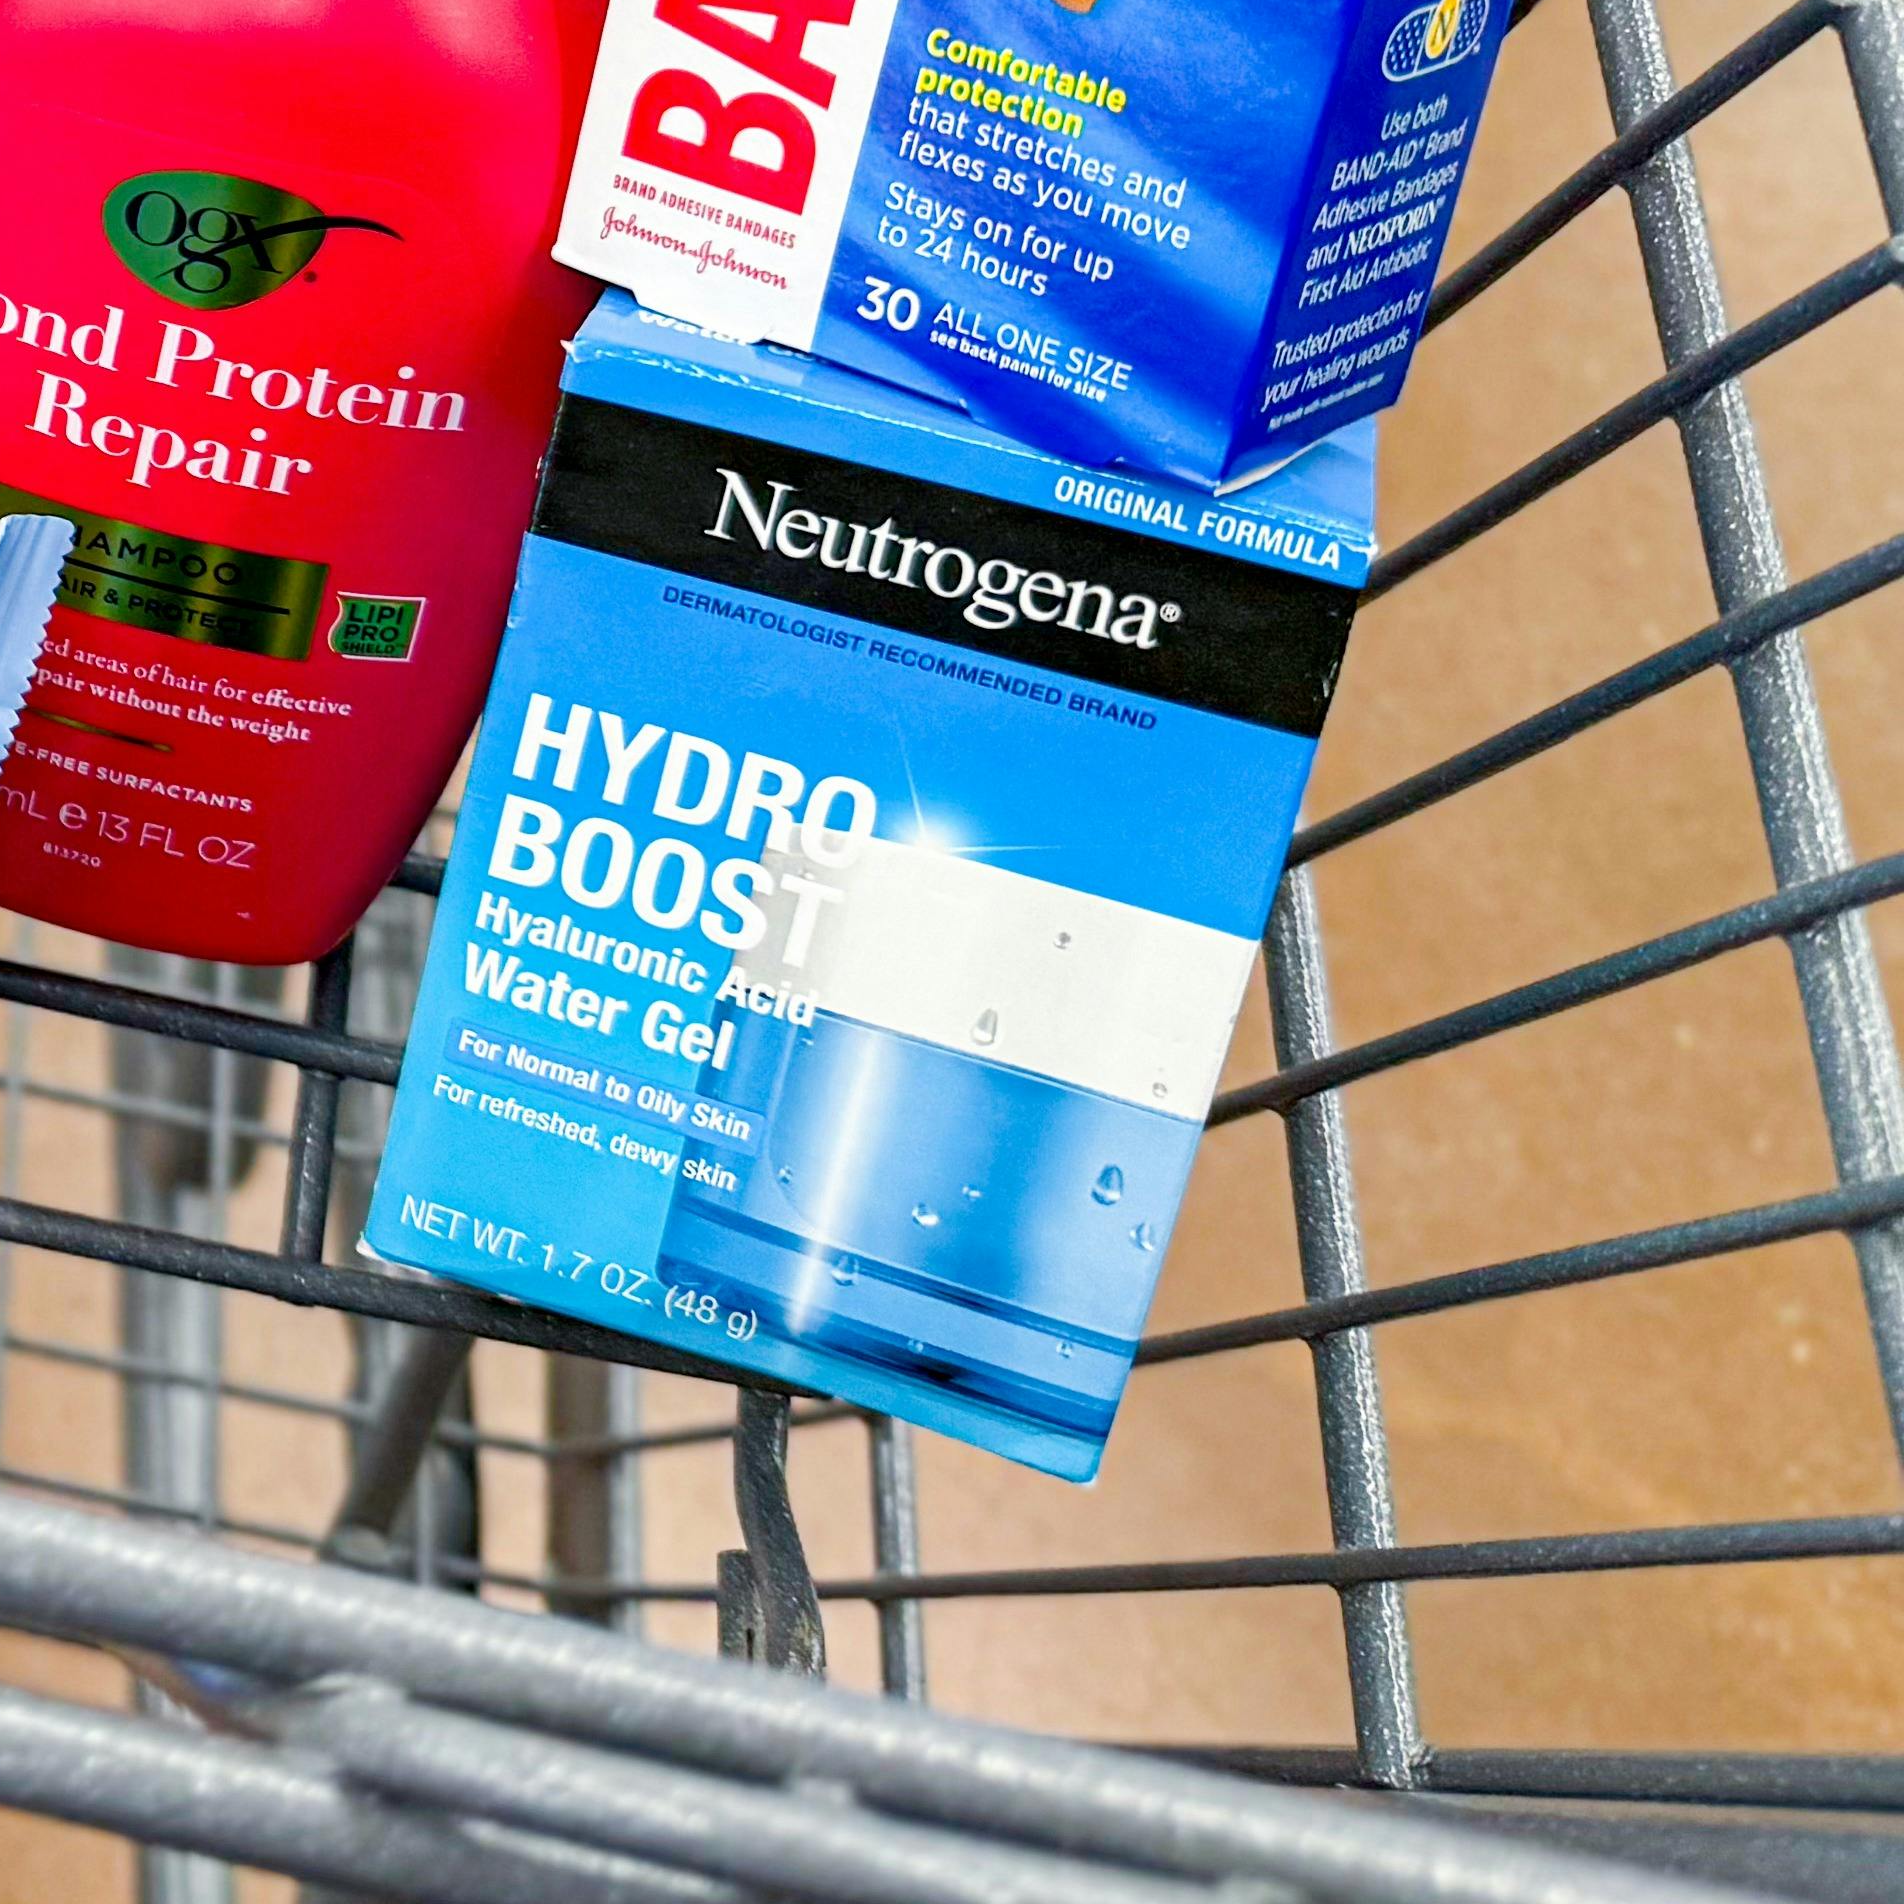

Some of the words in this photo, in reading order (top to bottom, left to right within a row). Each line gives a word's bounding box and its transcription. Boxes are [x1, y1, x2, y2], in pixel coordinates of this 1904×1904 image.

[914, 66, 1084, 138] protection
[926, 28, 1127, 113] Comfortable
[613, 174, 657, 200] BRAND
[659, 191, 723, 224] ADHESIVE
[726, 213, 796, 249] BANDAGES
[146, 320, 466, 432] Protein
[857, 275, 921, 332] 30
[934, 303, 991, 346] ALL
[997, 322, 1058, 364] ONE
[1067, 347, 1133, 390] SIZE
[24, 370, 314, 496] Repair
[1053, 475, 1191, 532] ORIGINAL
[1196, 509, 1341, 572] FORMULA
[512, 692, 876, 869] HYDRO
[96, 810, 128, 844] 13
[139, 823, 185, 858] FL
[197, 836, 257, 869] OZ
[488, 792, 844, 969] BOOST
[466, 942, 630, 1035] Water
[640, 999, 736, 1072] Gel
[475, 891, 706, 995] Hyaluronic
[714, 964, 821, 1028] Acid
